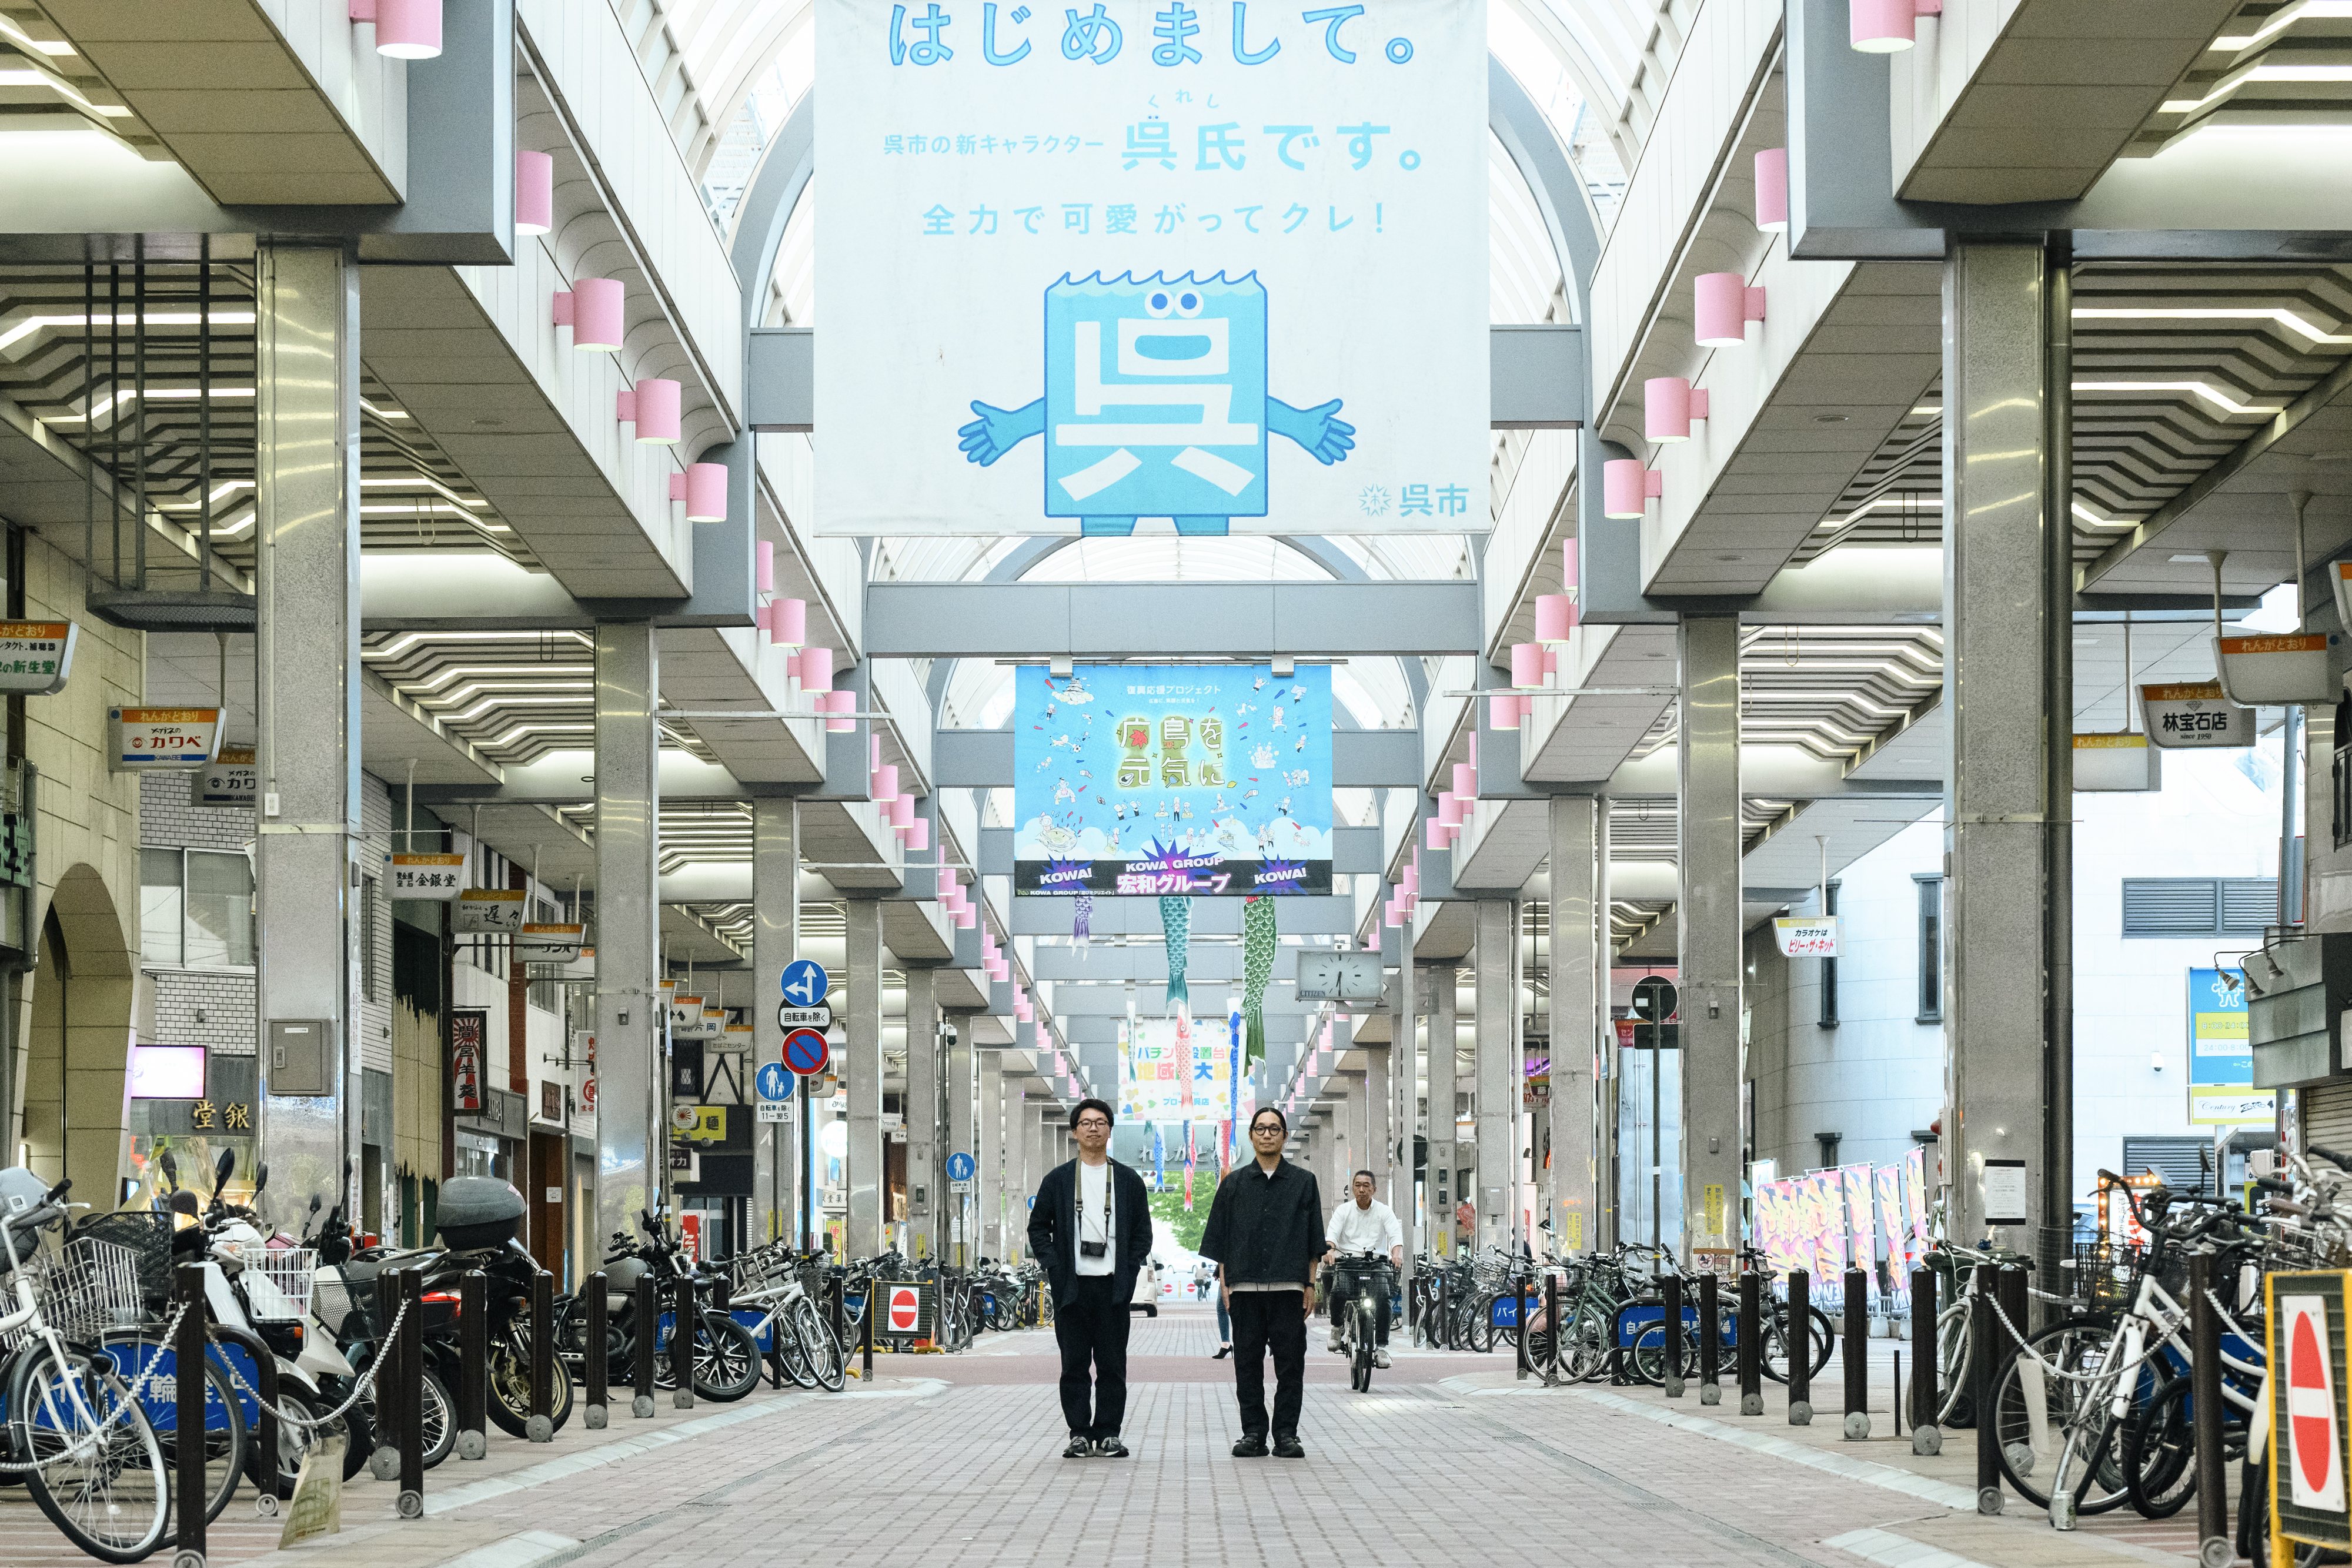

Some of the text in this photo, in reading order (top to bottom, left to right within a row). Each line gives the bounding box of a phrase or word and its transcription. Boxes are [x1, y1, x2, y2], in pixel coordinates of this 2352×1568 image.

[890, 2, 1414, 66] はじめまして。
[1148, 89, 1221, 109] くれし
[883, 121, 1421, 172] 呉市の新キャラクター 呉氏です。
[1398, 483, 1469, 518] 呉市
[0, 660, 55, 674] の新生堂
[1127, 685, 1221, 695] 復興応援プロジェクト
[2163, 711, 2227, 732] 林宝石店
[150, 736, 201, 748] カワベ
[1125, 857, 1225, 872] KOWA GROUP
[416, 873, 456, 887] 金銀堂
[1040, 868, 1093, 884] KOWA!
[1117, 873, 1231, 894] 宏和グループ
[1254, 867, 1307, 884] KOWA!
[784, 1012, 825, 1022] 自転車を除く
[2199, 1101, 2235, 1113] Century
